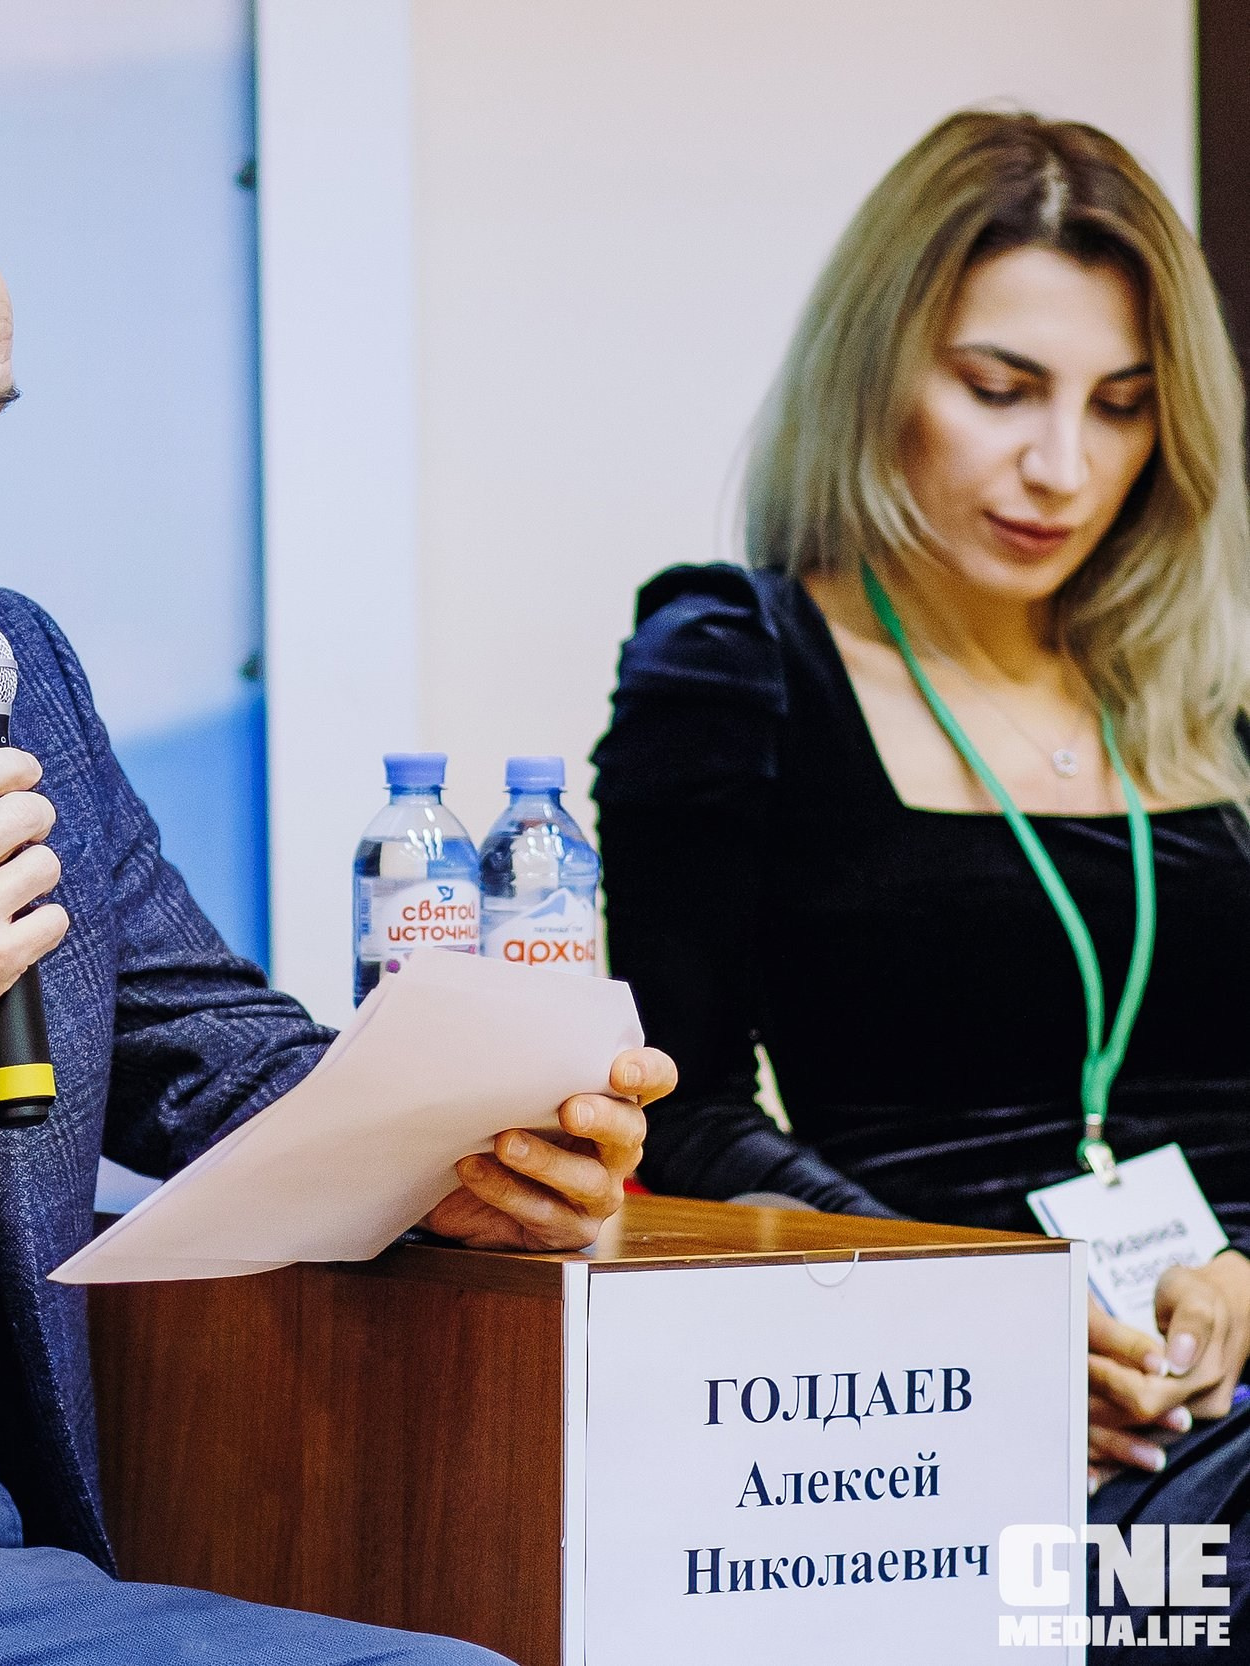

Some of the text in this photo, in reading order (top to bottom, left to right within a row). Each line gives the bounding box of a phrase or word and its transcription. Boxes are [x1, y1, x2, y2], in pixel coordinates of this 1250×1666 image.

[703, 1366, 972, 1430] ГОЛДАЕВ
[735, 1451, 941, 1508] Алексей
[682, 1544, 990, 1596] Николаевич
